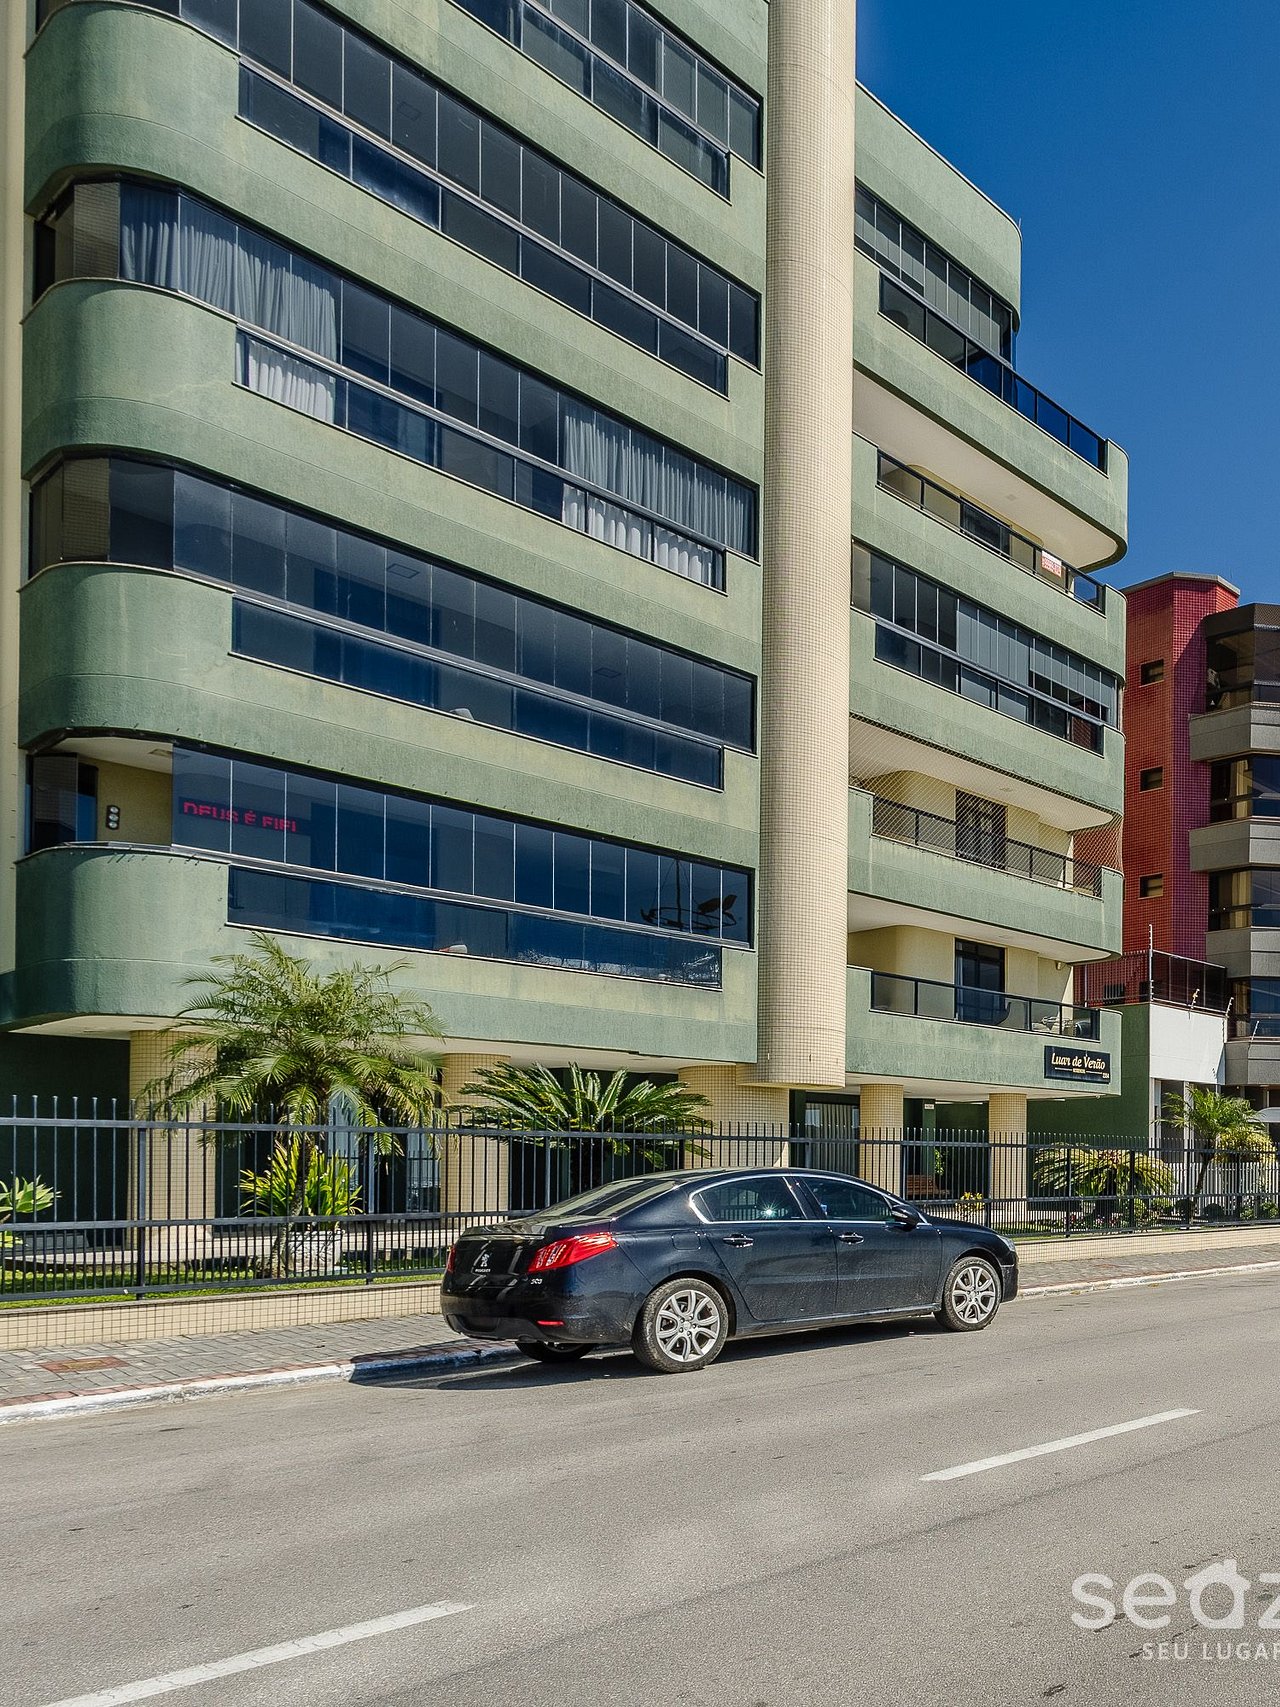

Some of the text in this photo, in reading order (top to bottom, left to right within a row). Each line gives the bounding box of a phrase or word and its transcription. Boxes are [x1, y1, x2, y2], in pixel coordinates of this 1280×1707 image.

[1051, 1053, 1106, 1070] Luar de Verão
